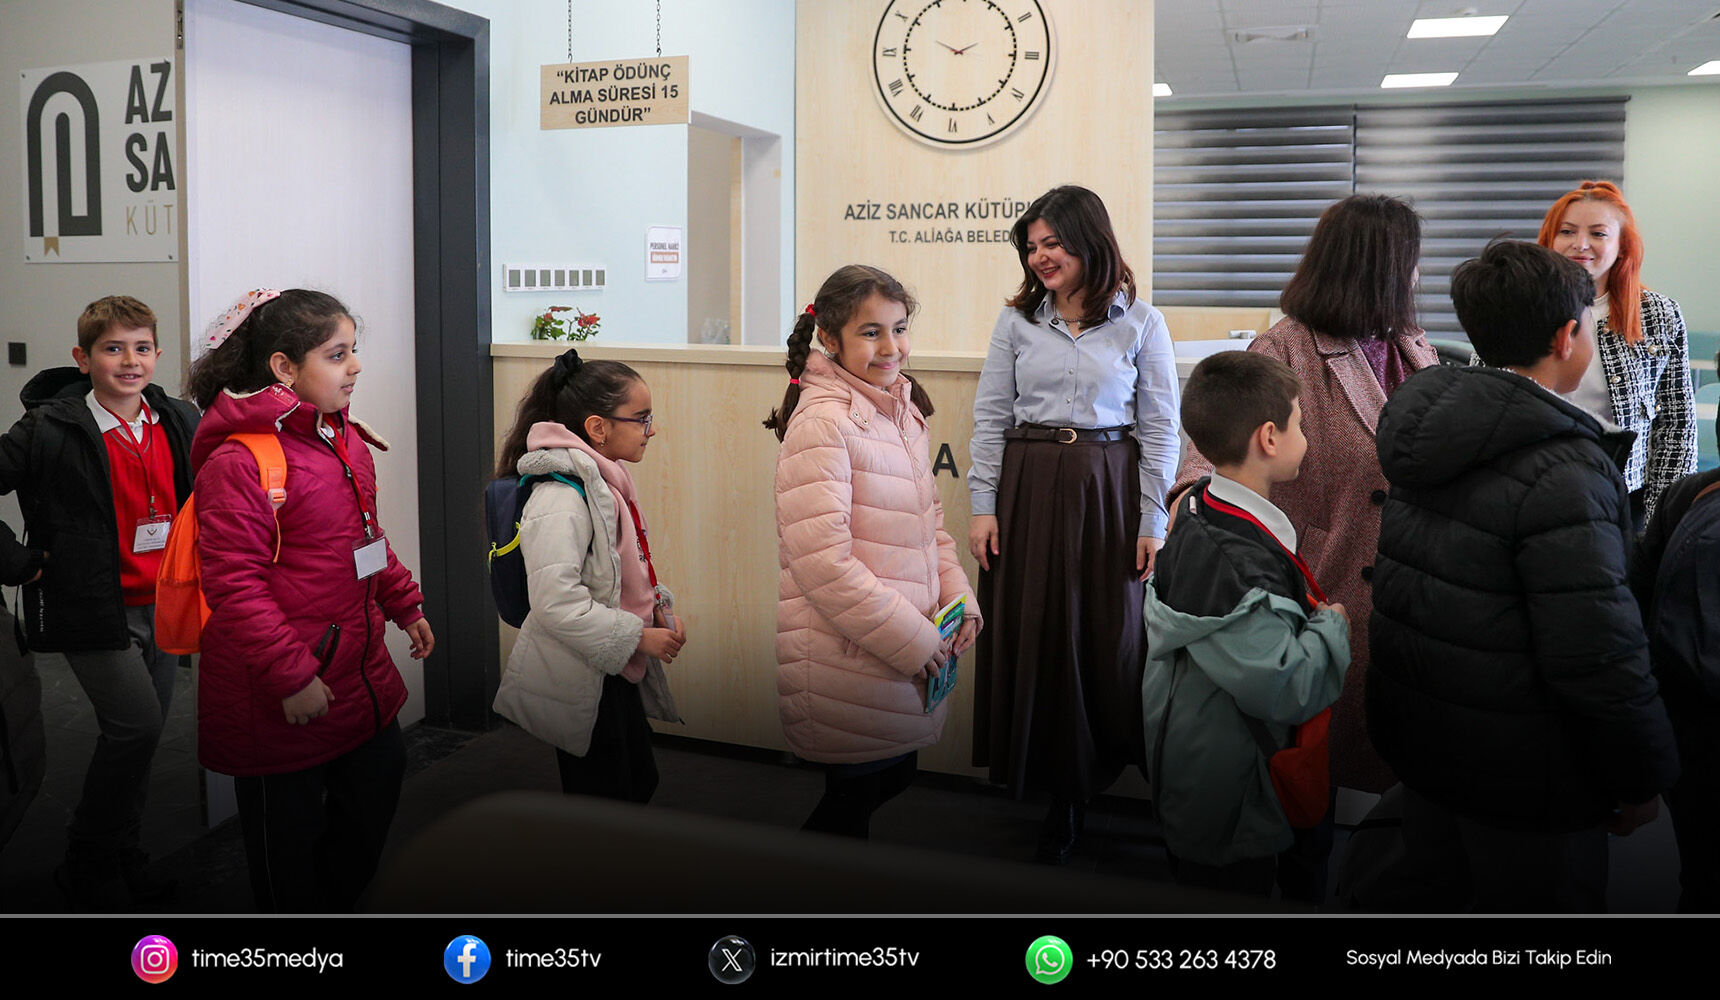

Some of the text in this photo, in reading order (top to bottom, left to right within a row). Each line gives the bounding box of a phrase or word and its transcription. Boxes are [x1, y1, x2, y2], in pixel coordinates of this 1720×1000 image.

[613, 62, 671, 81] ÖDÜNÇ
[125, 62, 173, 124] AZ
[549, 83, 679, 105] ALMA SÜRESİ 15
[125, 131, 176, 193] SA
[126, 199, 174, 235] KÜT
[844, 198, 1031, 220] AZİZ SANCAR KÜTÜP
[889, 230, 911, 243] T.C.
[914, 228, 963, 243] ALİAĞA
[932, 443, 960, 478] A
